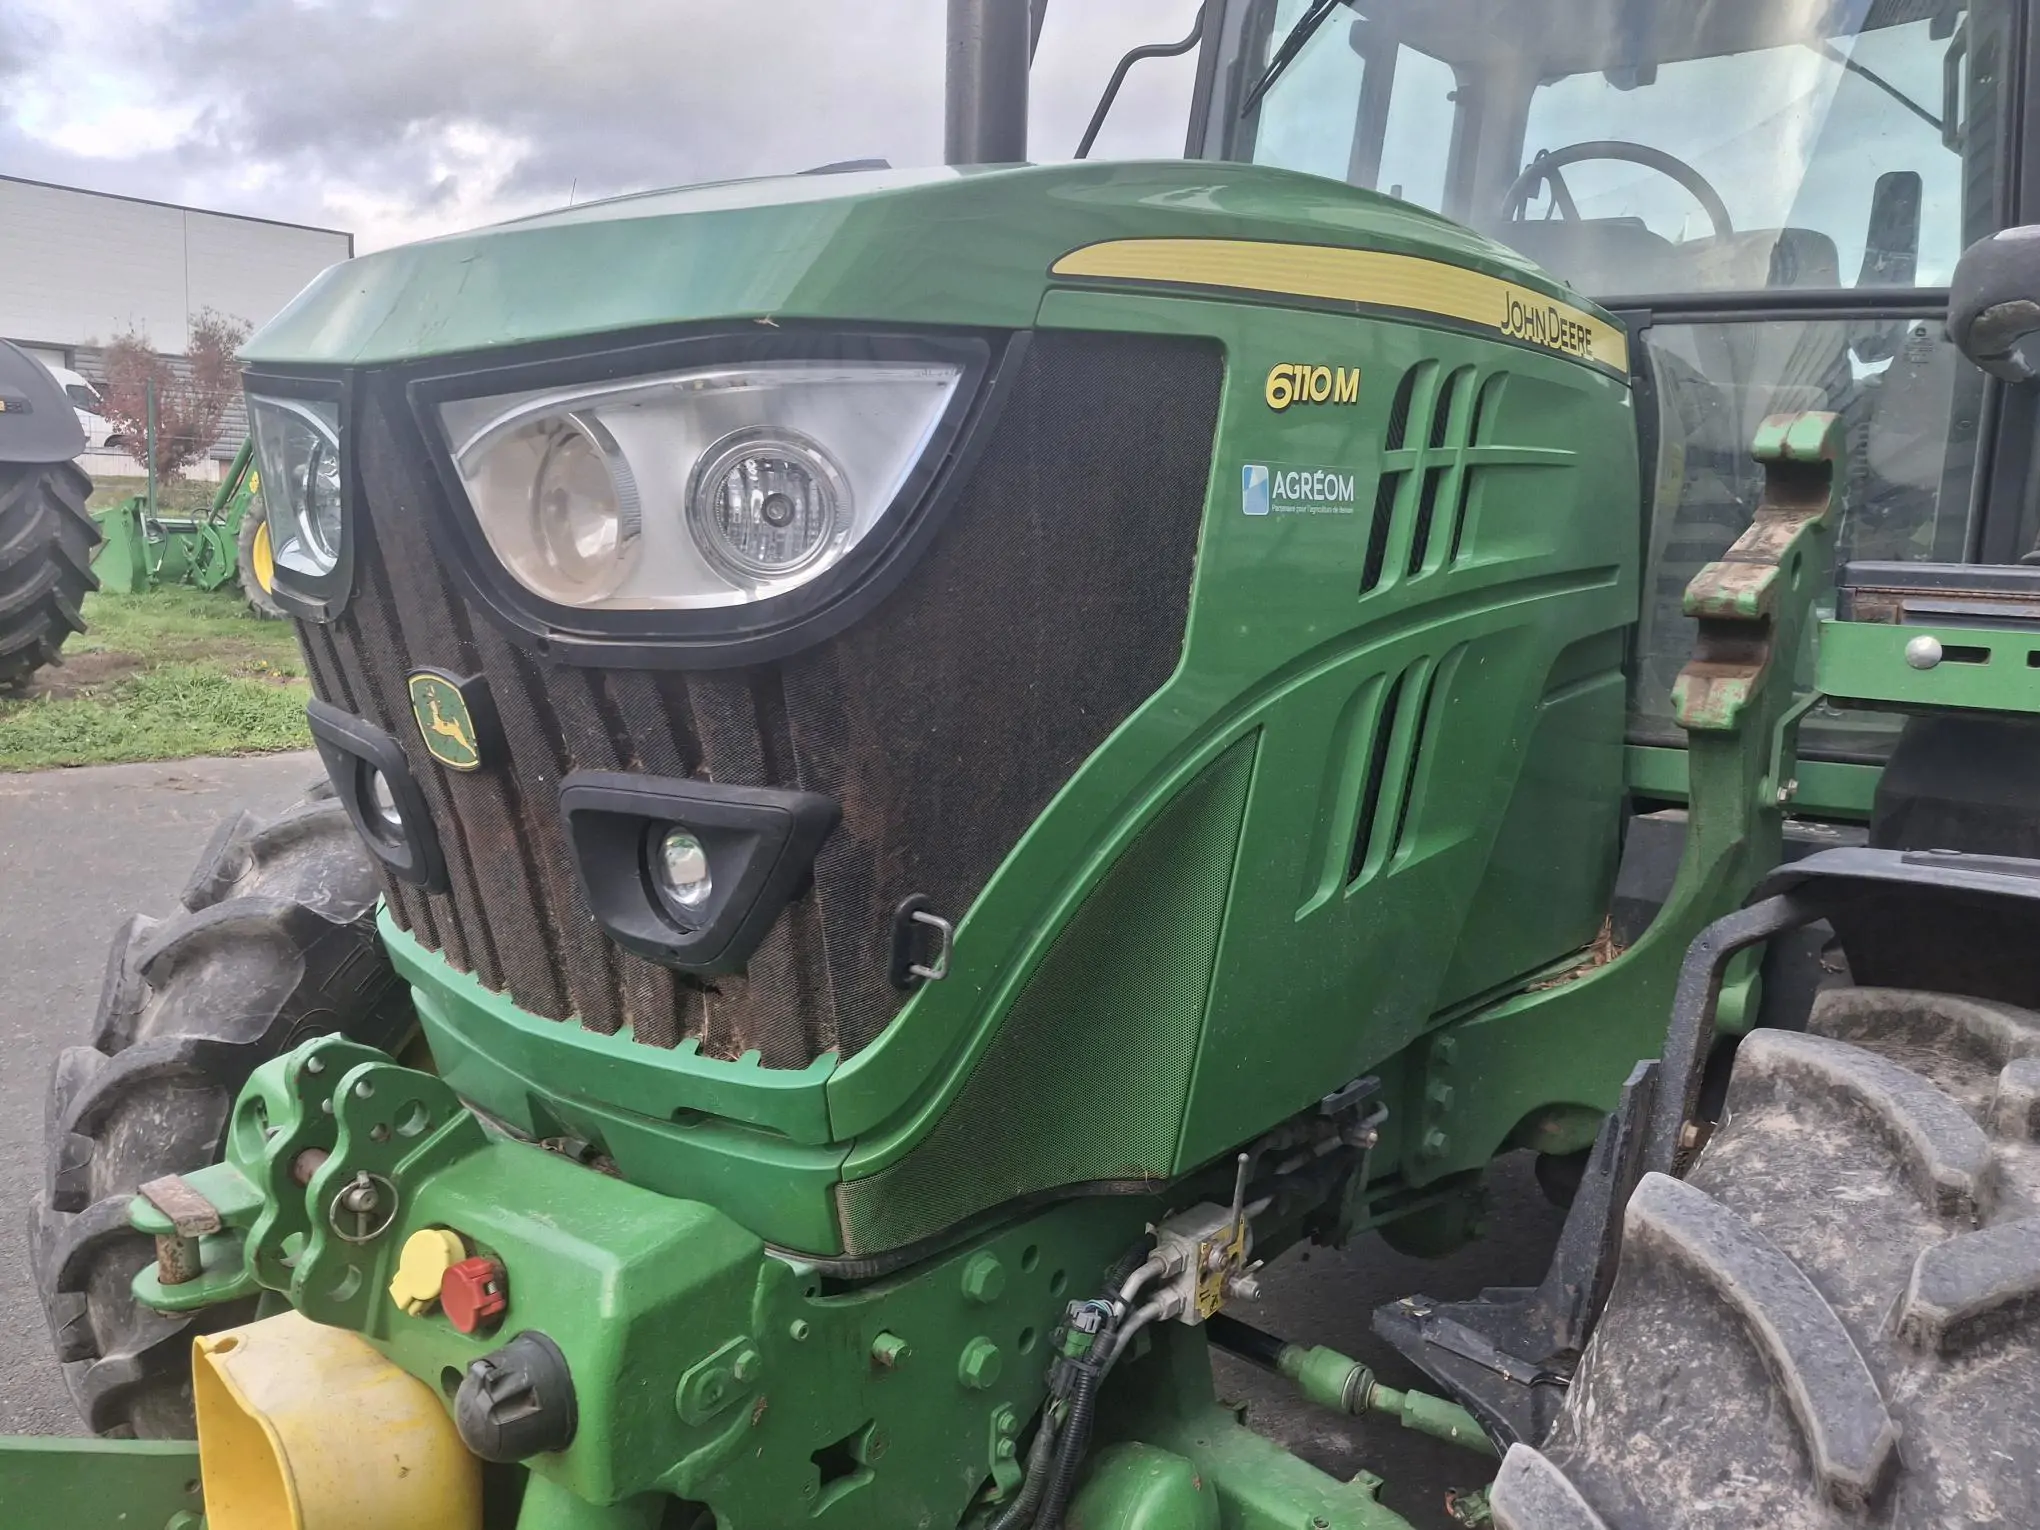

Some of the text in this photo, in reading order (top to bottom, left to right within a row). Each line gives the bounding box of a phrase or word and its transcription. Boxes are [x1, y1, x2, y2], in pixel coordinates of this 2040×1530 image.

[1501, 291, 1593, 357] JOHN DEERE
[1272, 470, 1354, 502] AGRÉOM
